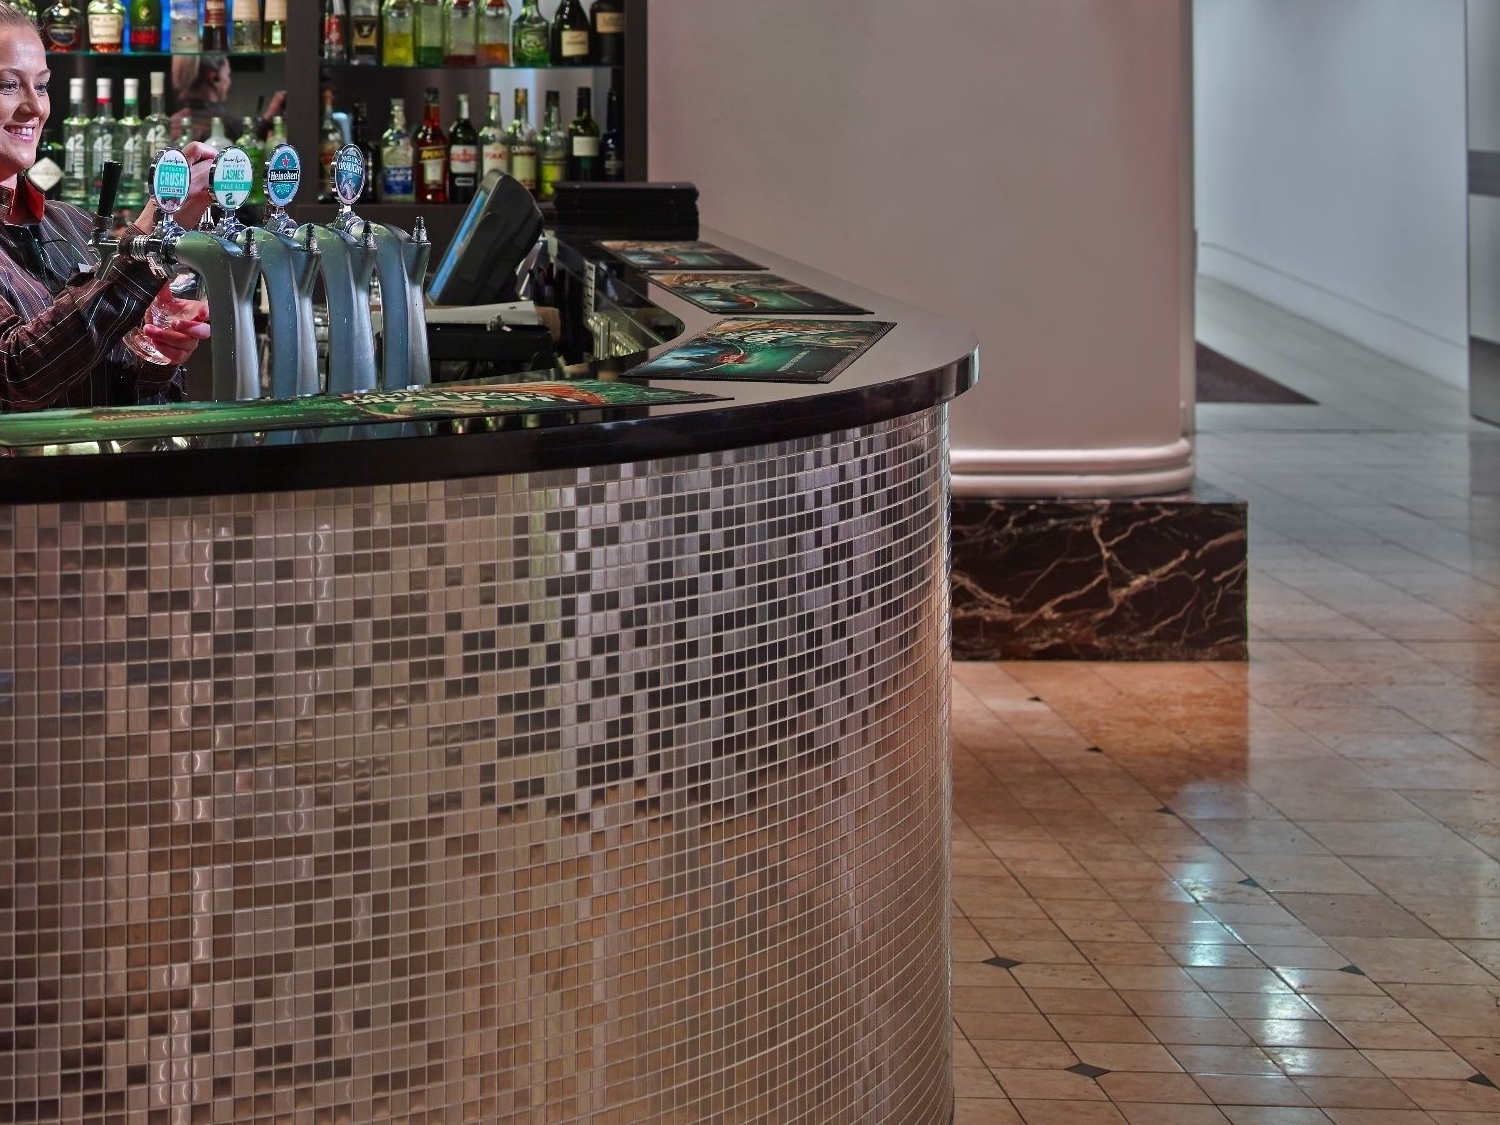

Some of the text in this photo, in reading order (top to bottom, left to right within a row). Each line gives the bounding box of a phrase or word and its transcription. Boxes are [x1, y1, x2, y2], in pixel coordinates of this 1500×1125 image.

[338, 161, 363, 175] DRAUGHT
[159, 172, 185, 186] CRUSH
[222, 169, 245, 181] LASHES
[269, 170, 299, 181] Heineken
